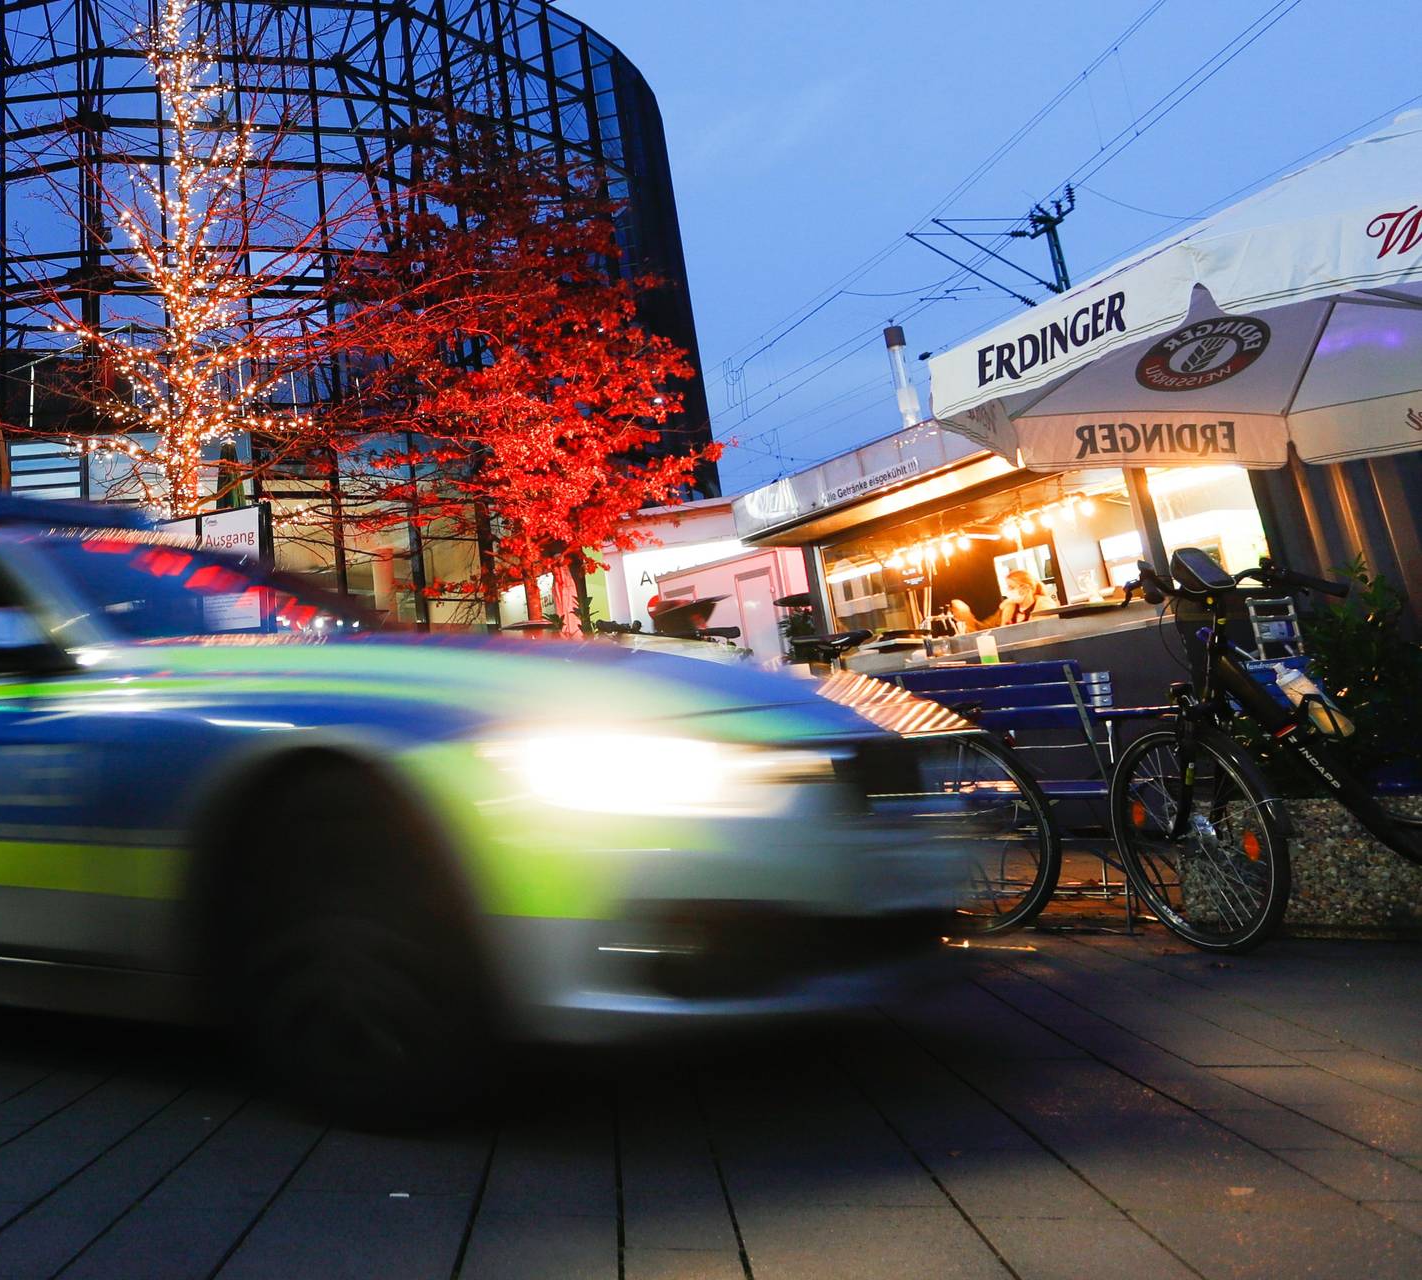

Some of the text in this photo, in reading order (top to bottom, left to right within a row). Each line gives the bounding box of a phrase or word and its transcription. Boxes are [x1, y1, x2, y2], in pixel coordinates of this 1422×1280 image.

[978, 291, 1126, 388] ERDINGER
[838, 481, 868, 498] Getränke
[869, 465, 907, 487] eisgekühlt
[206, 531, 255, 548] Ausgang
